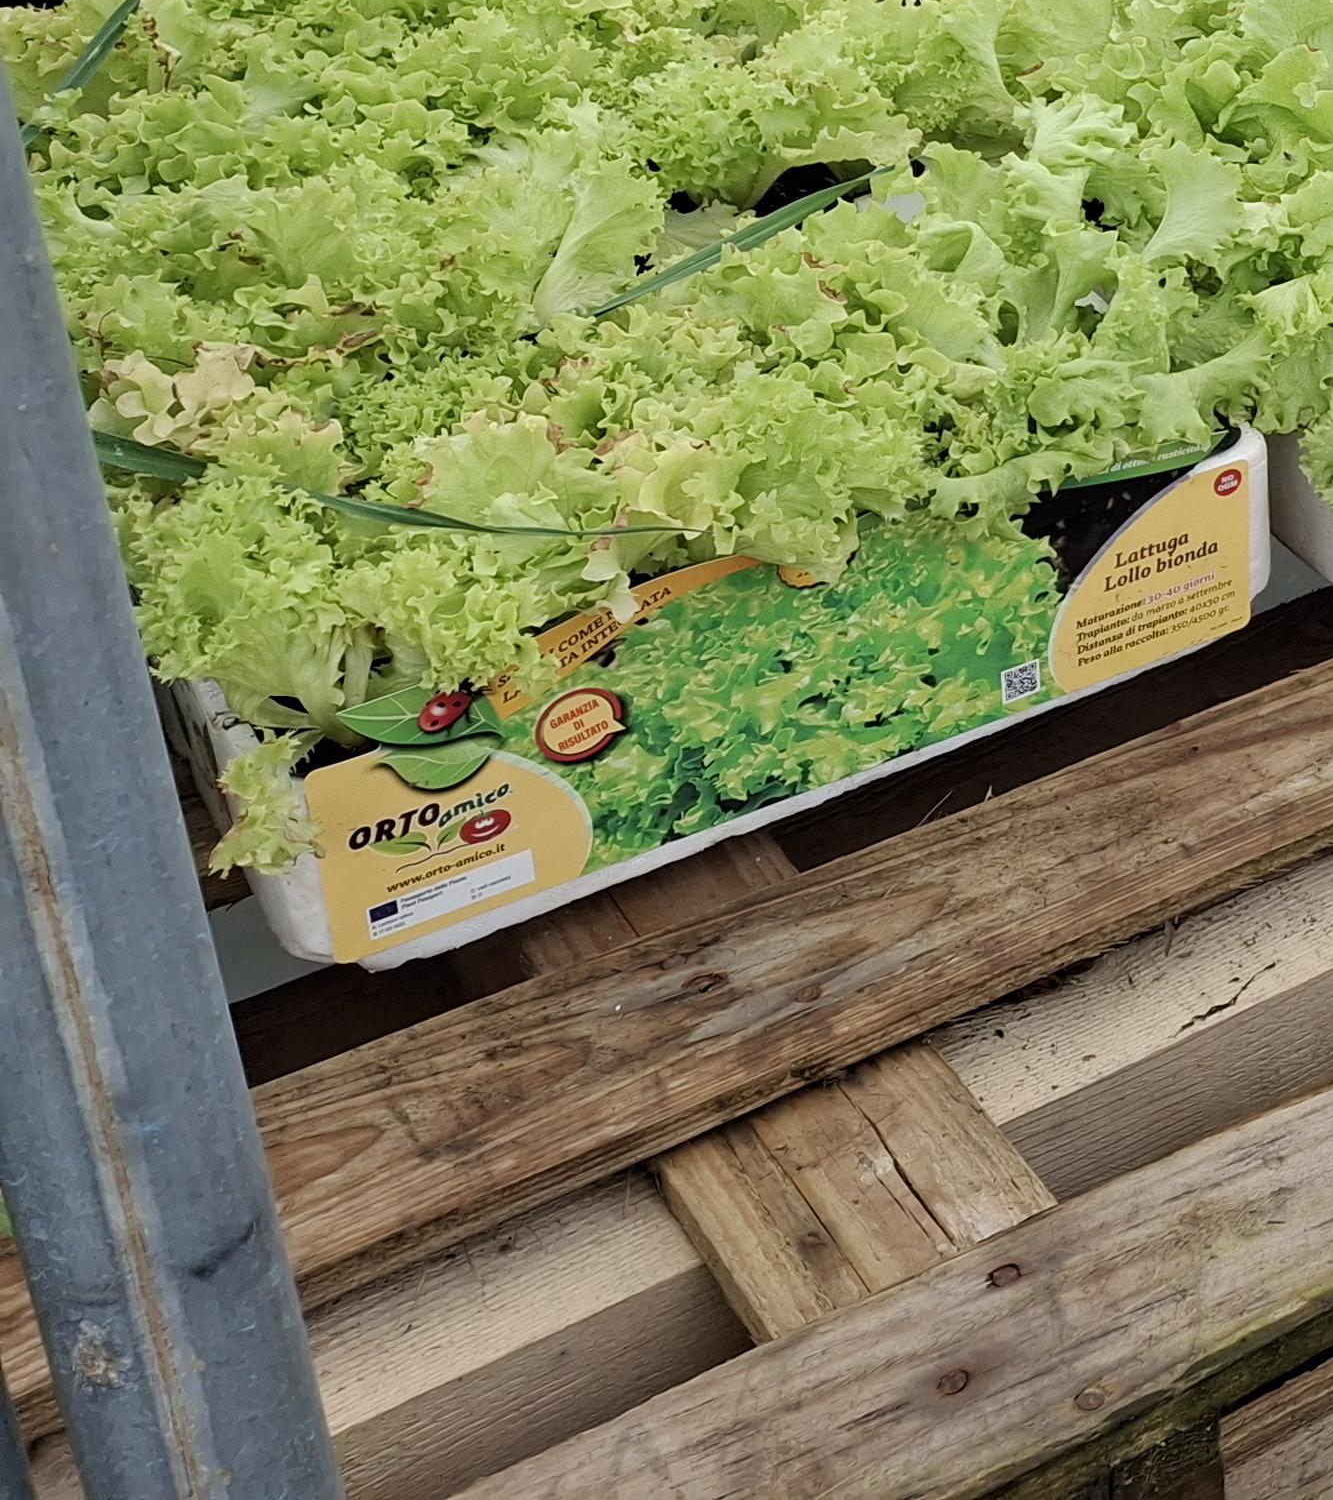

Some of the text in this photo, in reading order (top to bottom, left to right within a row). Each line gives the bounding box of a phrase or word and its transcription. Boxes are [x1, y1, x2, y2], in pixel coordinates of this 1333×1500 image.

[1221, 474, 1234, 483] NO
[1103, 540, 1218, 593] Lollo bionda
[1113, 533, 1189, 569] Lattuga
[1075, 572, 1216, 630] Maturazione: 30-40 giorni
[1075, 616, 1130, 643] Trapianto:
[1131, 611, 1144, 622] da
[1145, 600, 1176, 616] marzo
[1186, 578, 1233, 602] settembre
[1076, 631, 1124, 655] Distanza
[1125, 626, 1136, 637] di
[1137, 607, 1188, 633] trapianto:
[1221, 590, 1236, 602] cm
[558, 616, 604, 653] COME
[1077, 653, 1101, 667] Peso
[1103, 644, 1123, 658] alla
[1124, 627, 1169, 649] raccolta:
[1170, 609, 1217, 635] 350/4500
[549, 698, 600, 729] GARANZIA
[557, 720, 609, 752] RISULTATO
[573, 718, 585, 731] DI
[348, 783, 510, 851] ORTO amico
[386, 843, 506, 893] www.orto-amico.it
